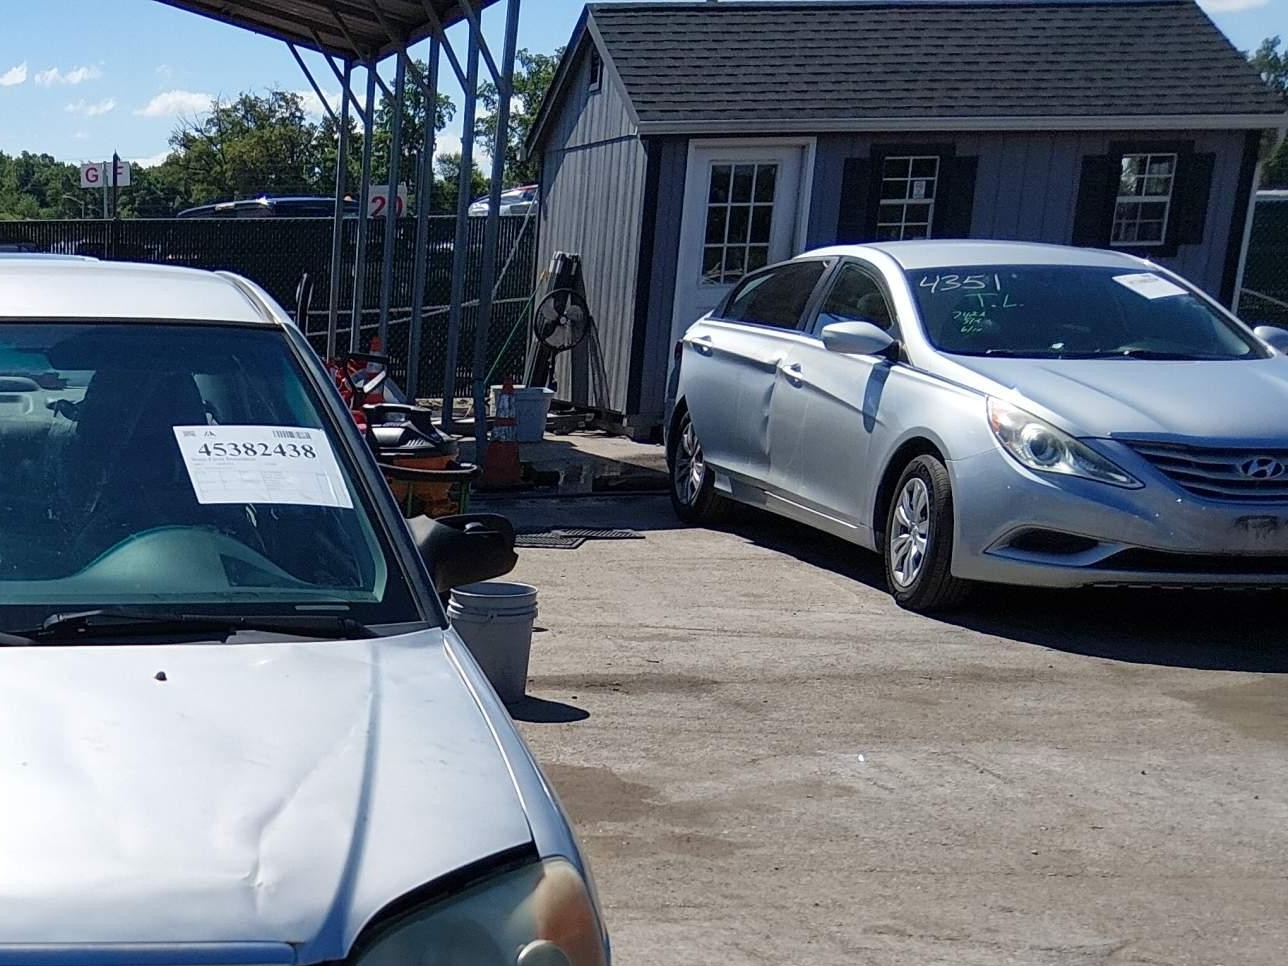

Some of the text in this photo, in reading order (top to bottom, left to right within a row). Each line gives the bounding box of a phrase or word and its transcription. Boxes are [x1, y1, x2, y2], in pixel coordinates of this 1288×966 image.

[85, 167, 99, 183] G
[919, 273, 1001, 294] 4351
[198, 442, 317, 459] 45382438
